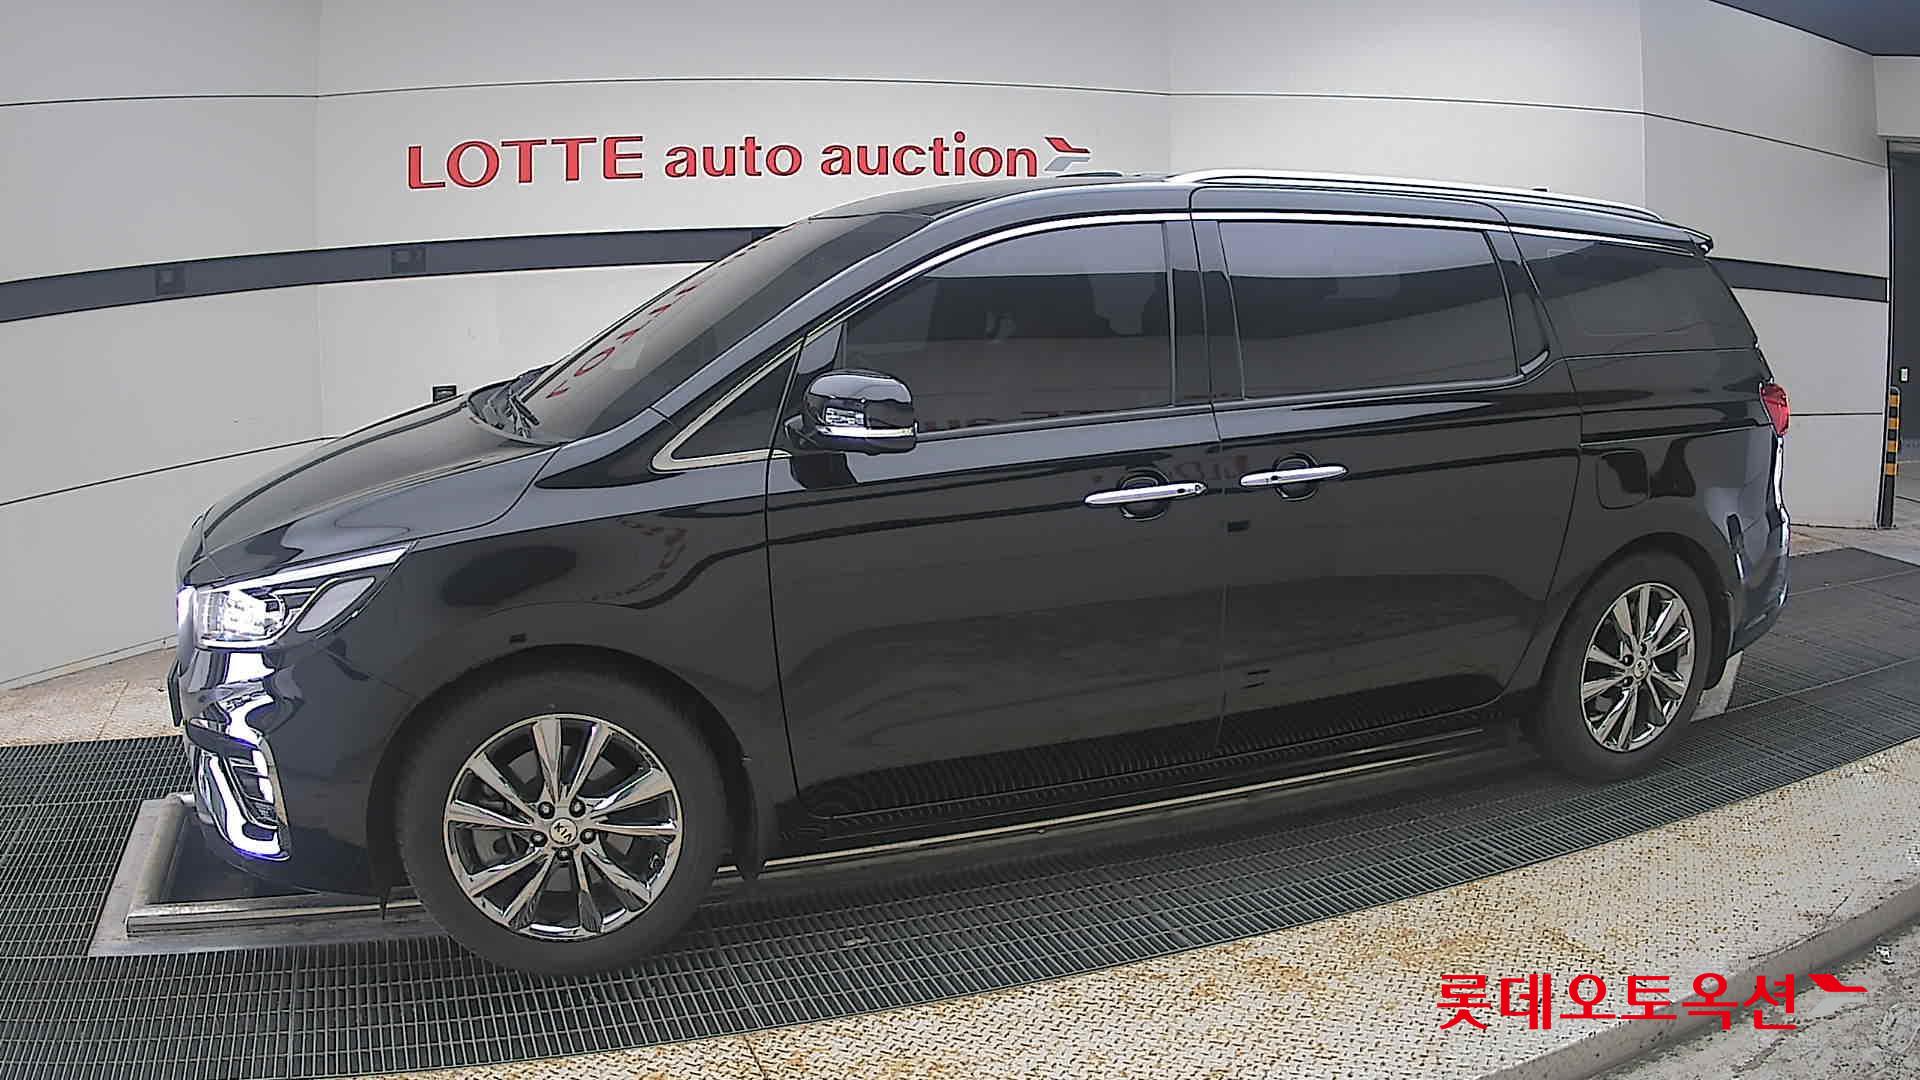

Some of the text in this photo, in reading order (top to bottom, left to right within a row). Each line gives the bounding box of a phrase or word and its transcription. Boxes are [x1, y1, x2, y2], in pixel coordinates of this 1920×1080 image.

[407, 131, 1039, 190] LOTTE auto auction
